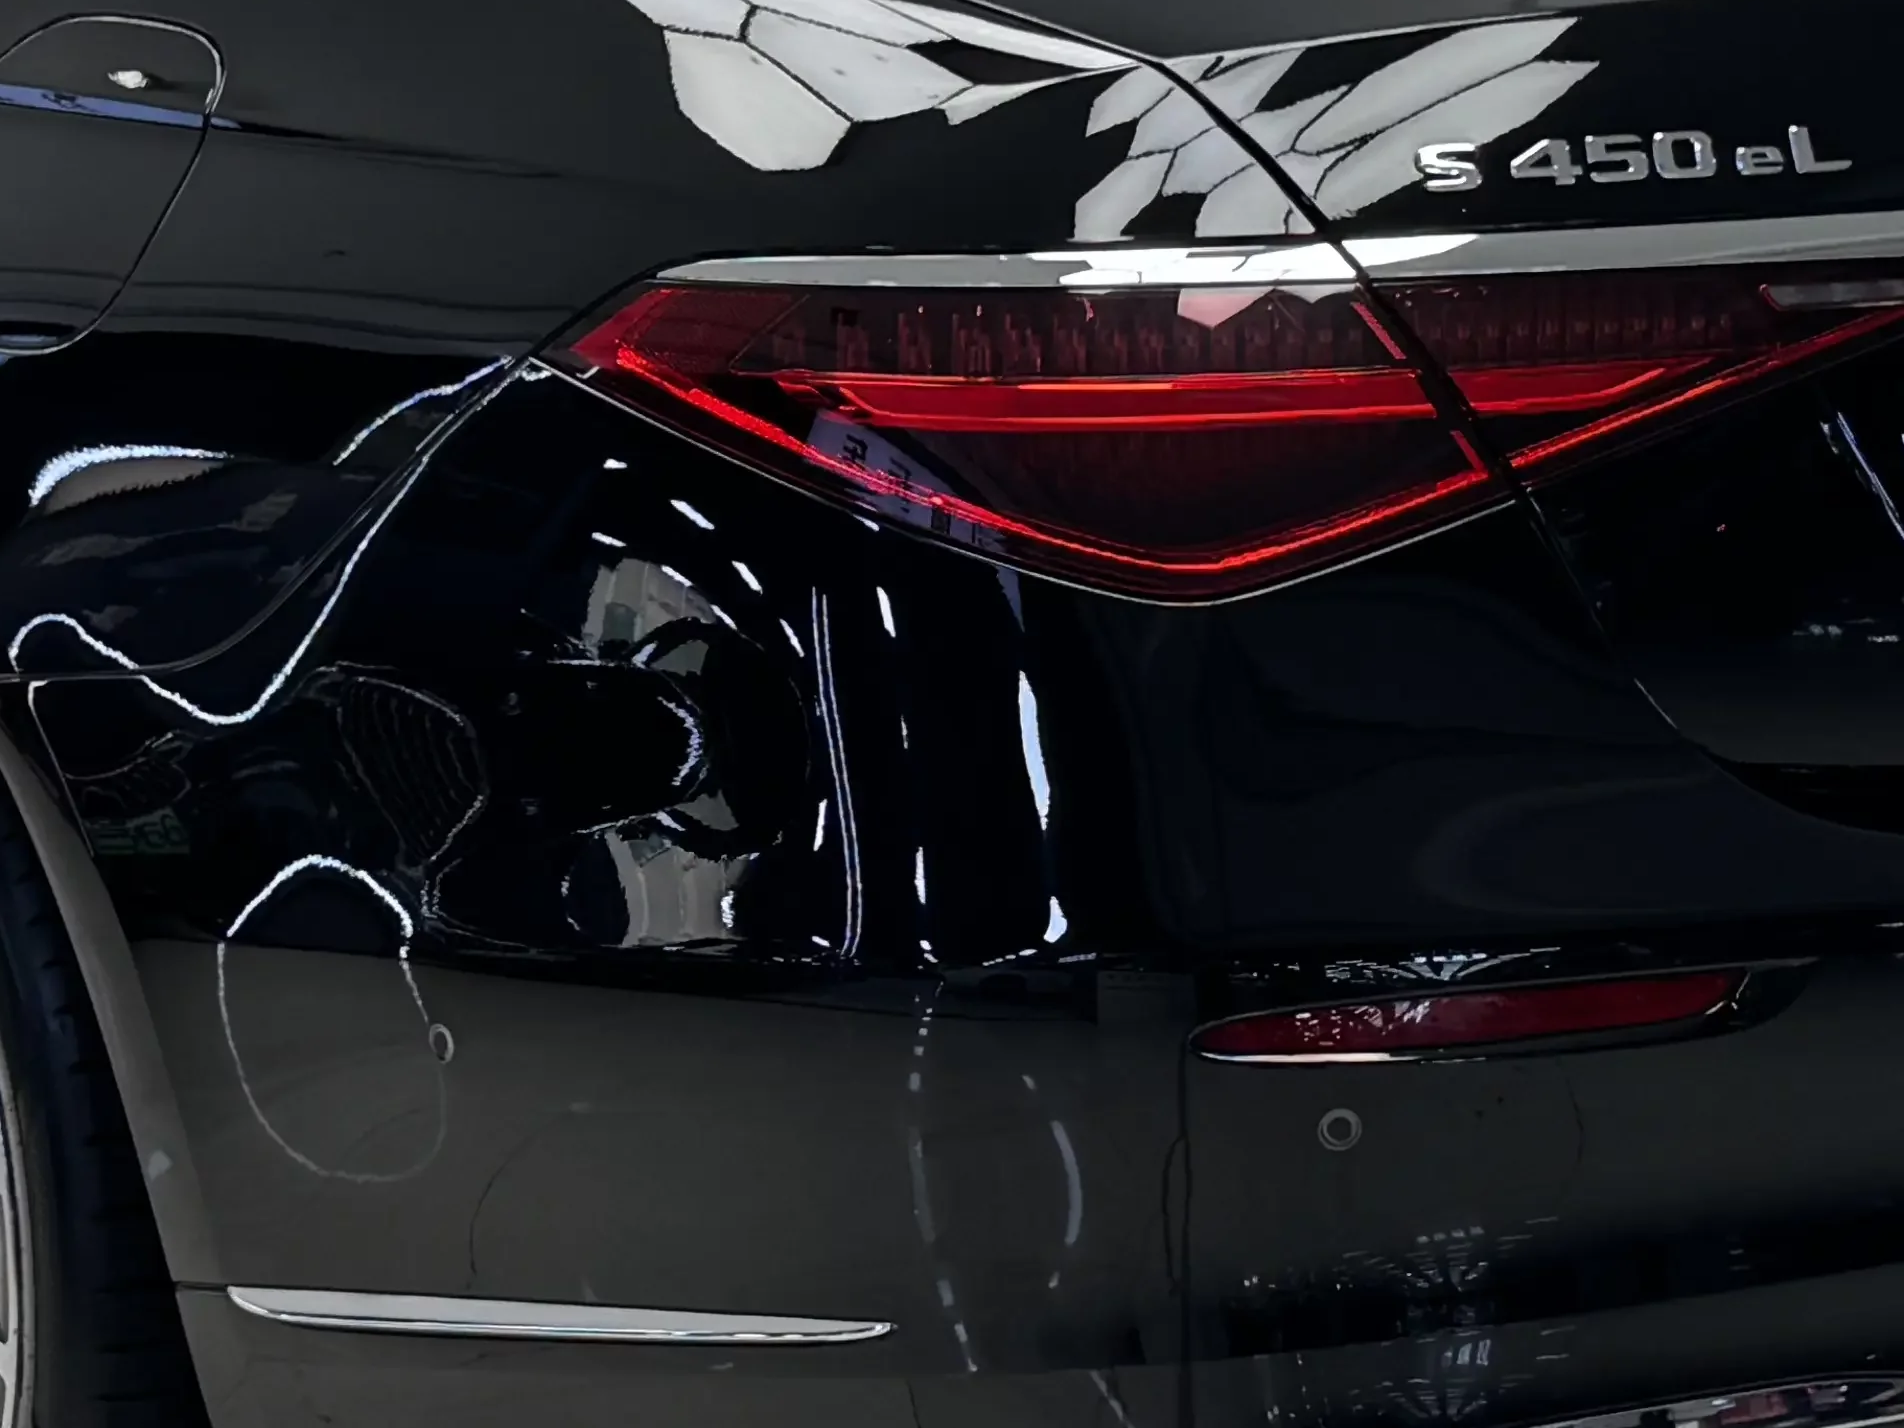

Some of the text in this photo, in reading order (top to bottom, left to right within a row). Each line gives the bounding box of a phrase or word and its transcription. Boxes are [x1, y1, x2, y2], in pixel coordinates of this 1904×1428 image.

[1414, 125, 1852, 192] S 450 eL
